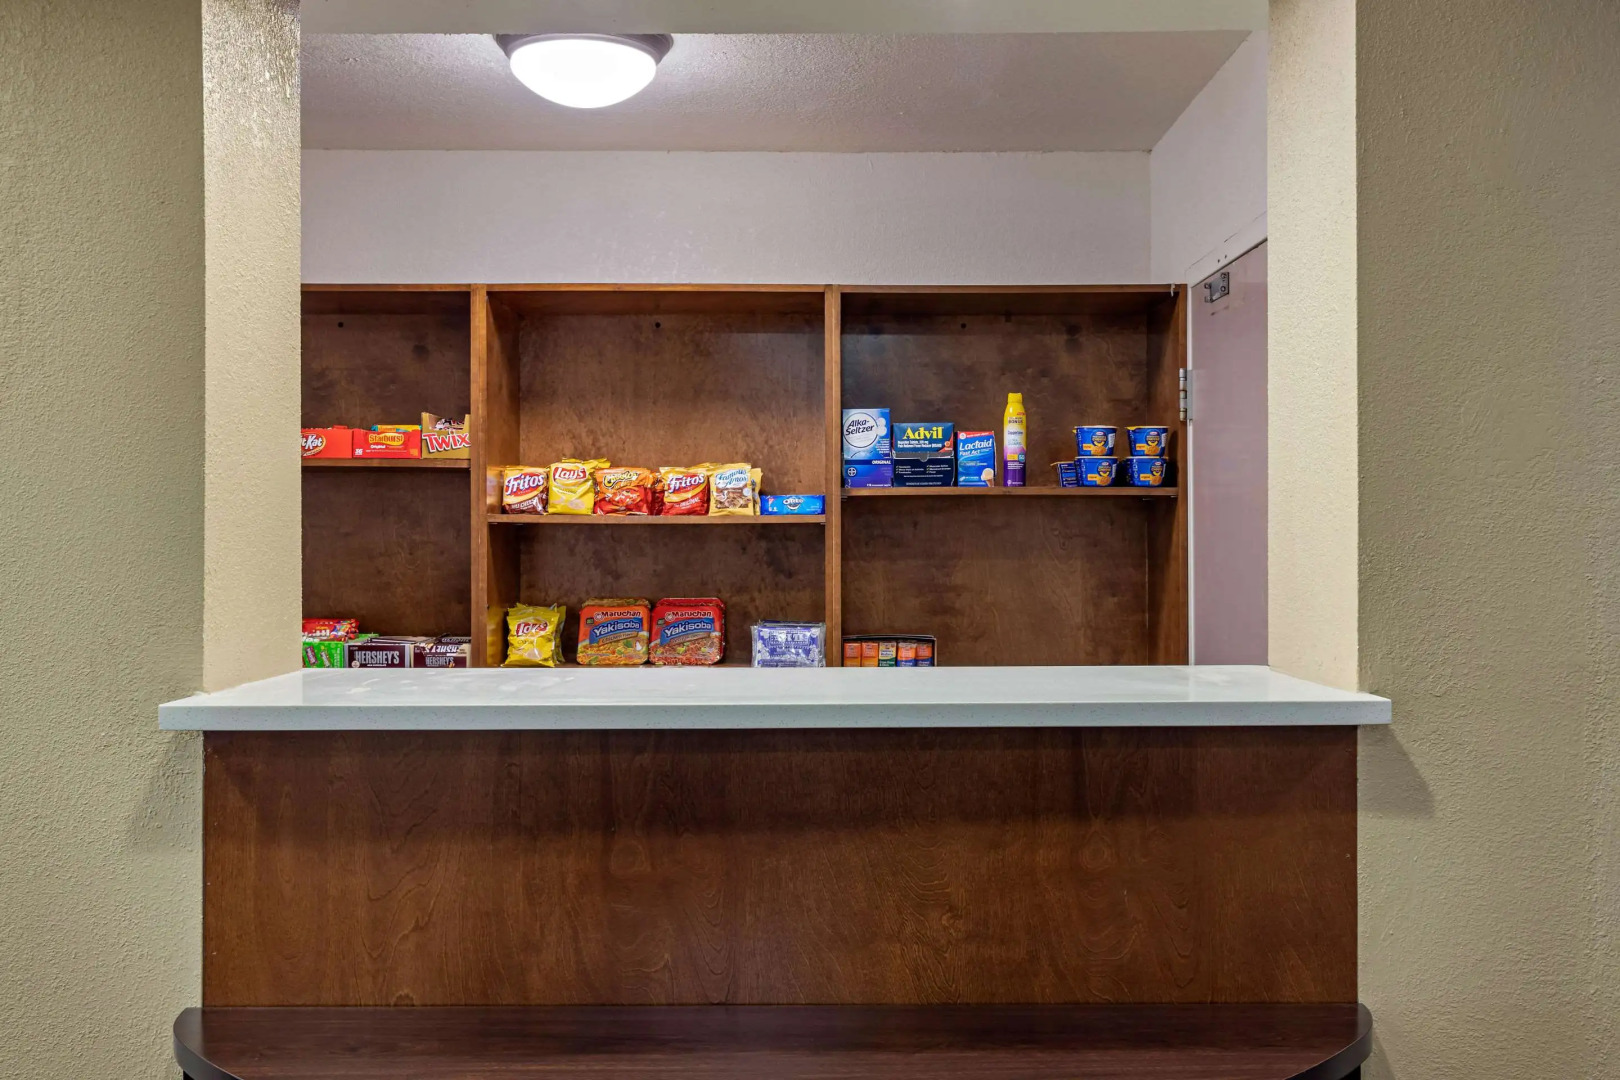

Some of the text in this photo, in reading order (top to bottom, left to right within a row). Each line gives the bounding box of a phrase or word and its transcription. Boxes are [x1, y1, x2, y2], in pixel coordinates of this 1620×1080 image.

[845, 425, 875, 435] Seltzer
[847, 419, 870, 428] Alka-
[369, 434, 403, 443] Starburst
[903, 427, 943, 439] Advil
[301, 434, 323, 450] tKat
[422, 429, 471, 452] Twix
[959, 438, 993, 451] Lactaid
[715, 469, 747, 482] Famous
[723, 476, 748, 488] Amos
[506, 474, 545, 495] Fritos
[668, 473, 705, 493] Fritos
[593, 620, 640, 637] Yakisoba
[664, 620, 712, 637] Yakisoba
[355, 651, 399, 664] HERSHEY'S
[425, 656, 454, 666] HERSHEY'S
